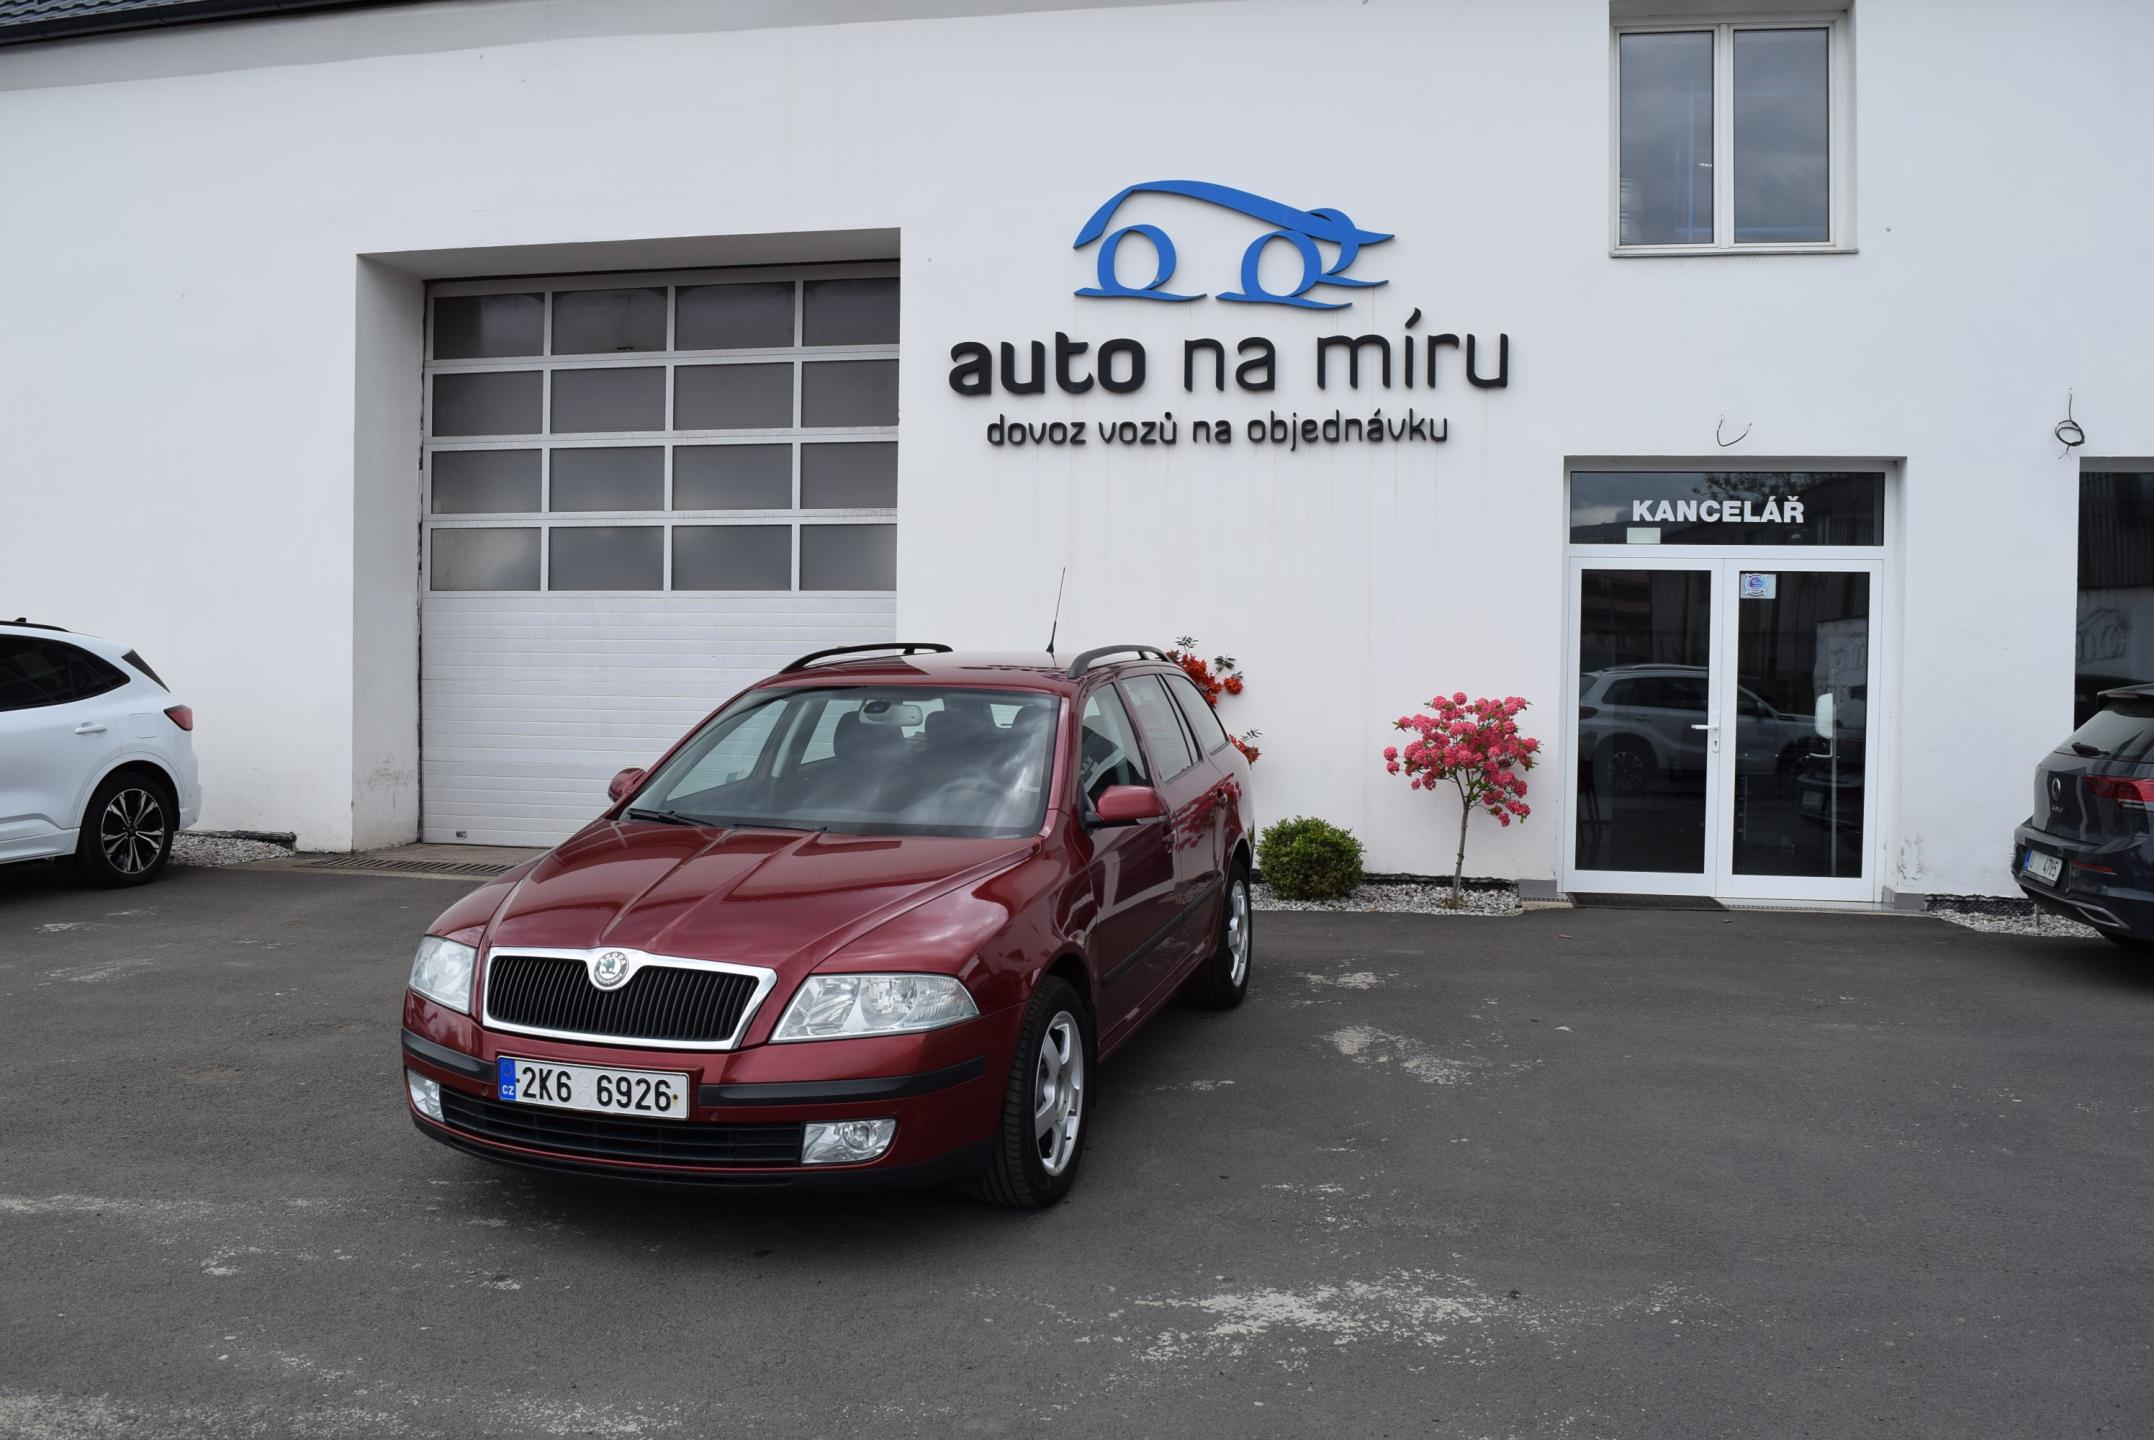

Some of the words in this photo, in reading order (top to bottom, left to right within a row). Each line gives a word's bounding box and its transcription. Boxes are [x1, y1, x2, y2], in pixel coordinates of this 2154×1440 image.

[948, 331, 1147, 395] auto
[1184, 336, 1276, 393] na
[1316, 307, 1509, 391] míru
[986, 414, 1087, 446] dovoz
[1098, 411, 1178, 445] vozů
[1192, 420, 1232, 445] na
[1247, 407, 1449, 452] objednávku
[1632, 495, 1805, 524] KANCELÁŘ
[502, 1084, 514, 1096] CZ
[522, 1066, 572, 1103] 2K6
[596, 1074, 671, 1112] 6926
